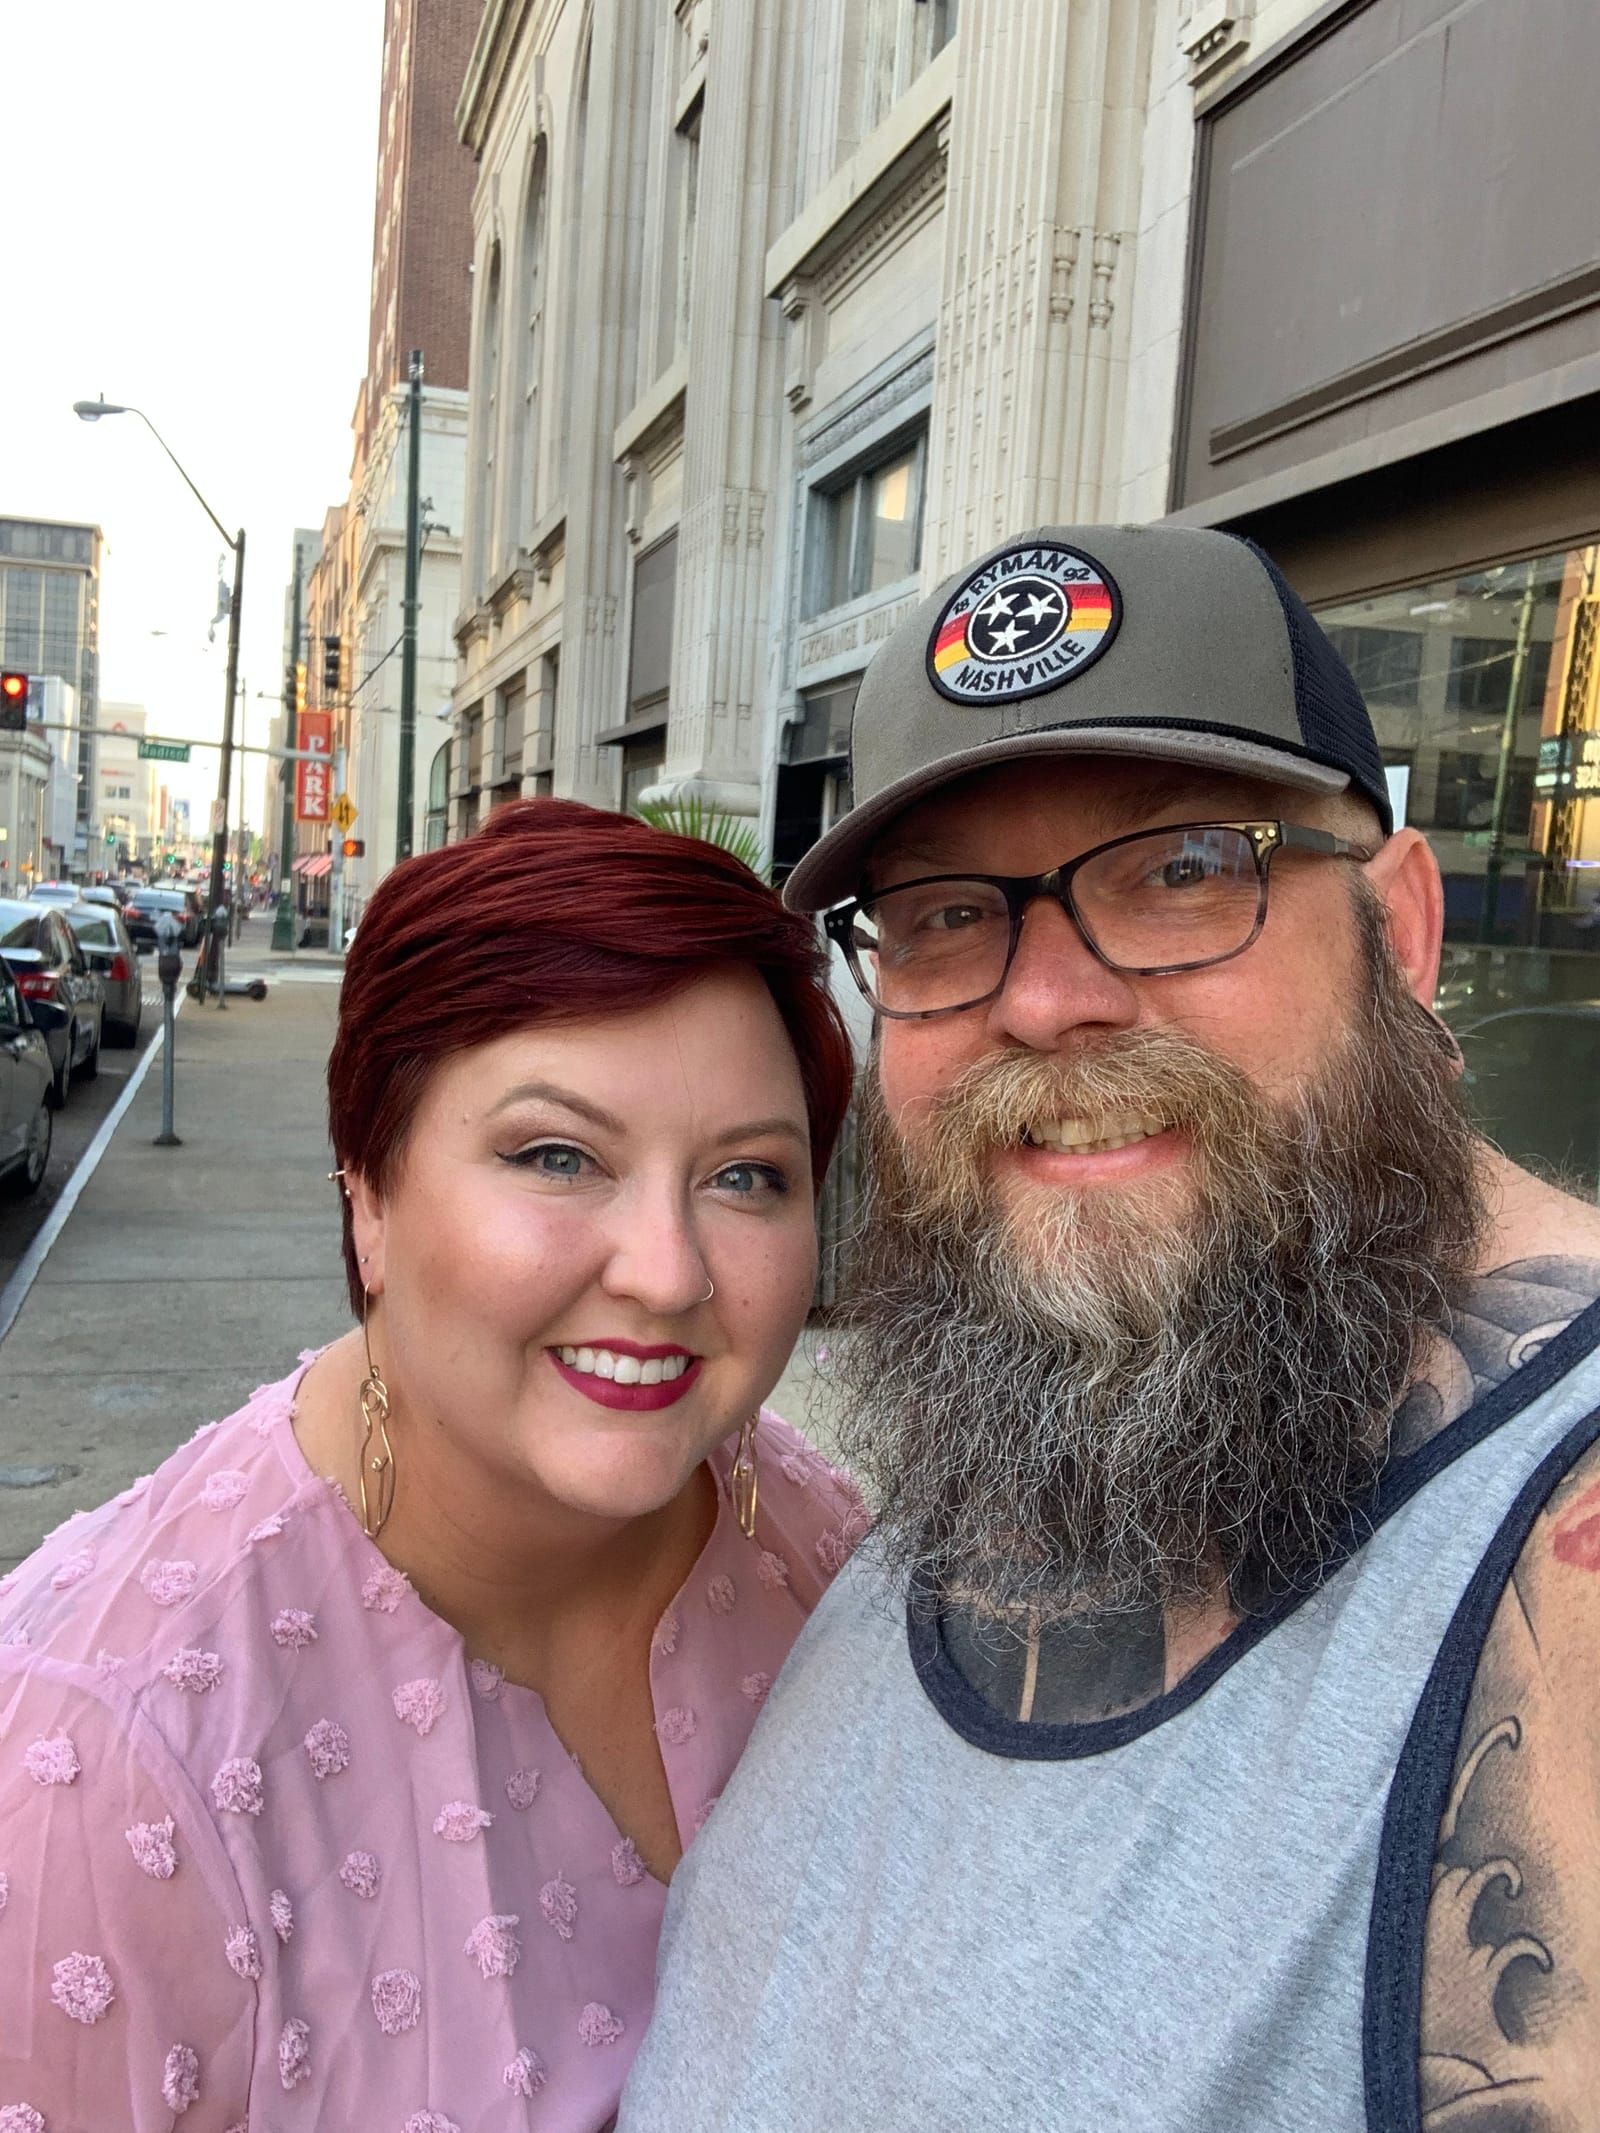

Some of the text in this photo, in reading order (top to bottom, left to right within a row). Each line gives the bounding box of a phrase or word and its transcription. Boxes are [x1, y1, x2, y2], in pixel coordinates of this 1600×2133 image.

[969, 550, 1069, 597] RYMAN
[1063, 567, 1091, 582] 92
[954, 638, 1085, 693] NASHVILLE
[140, 743, 188, 761] Madison
[303, 735, 326, 816] PARK
